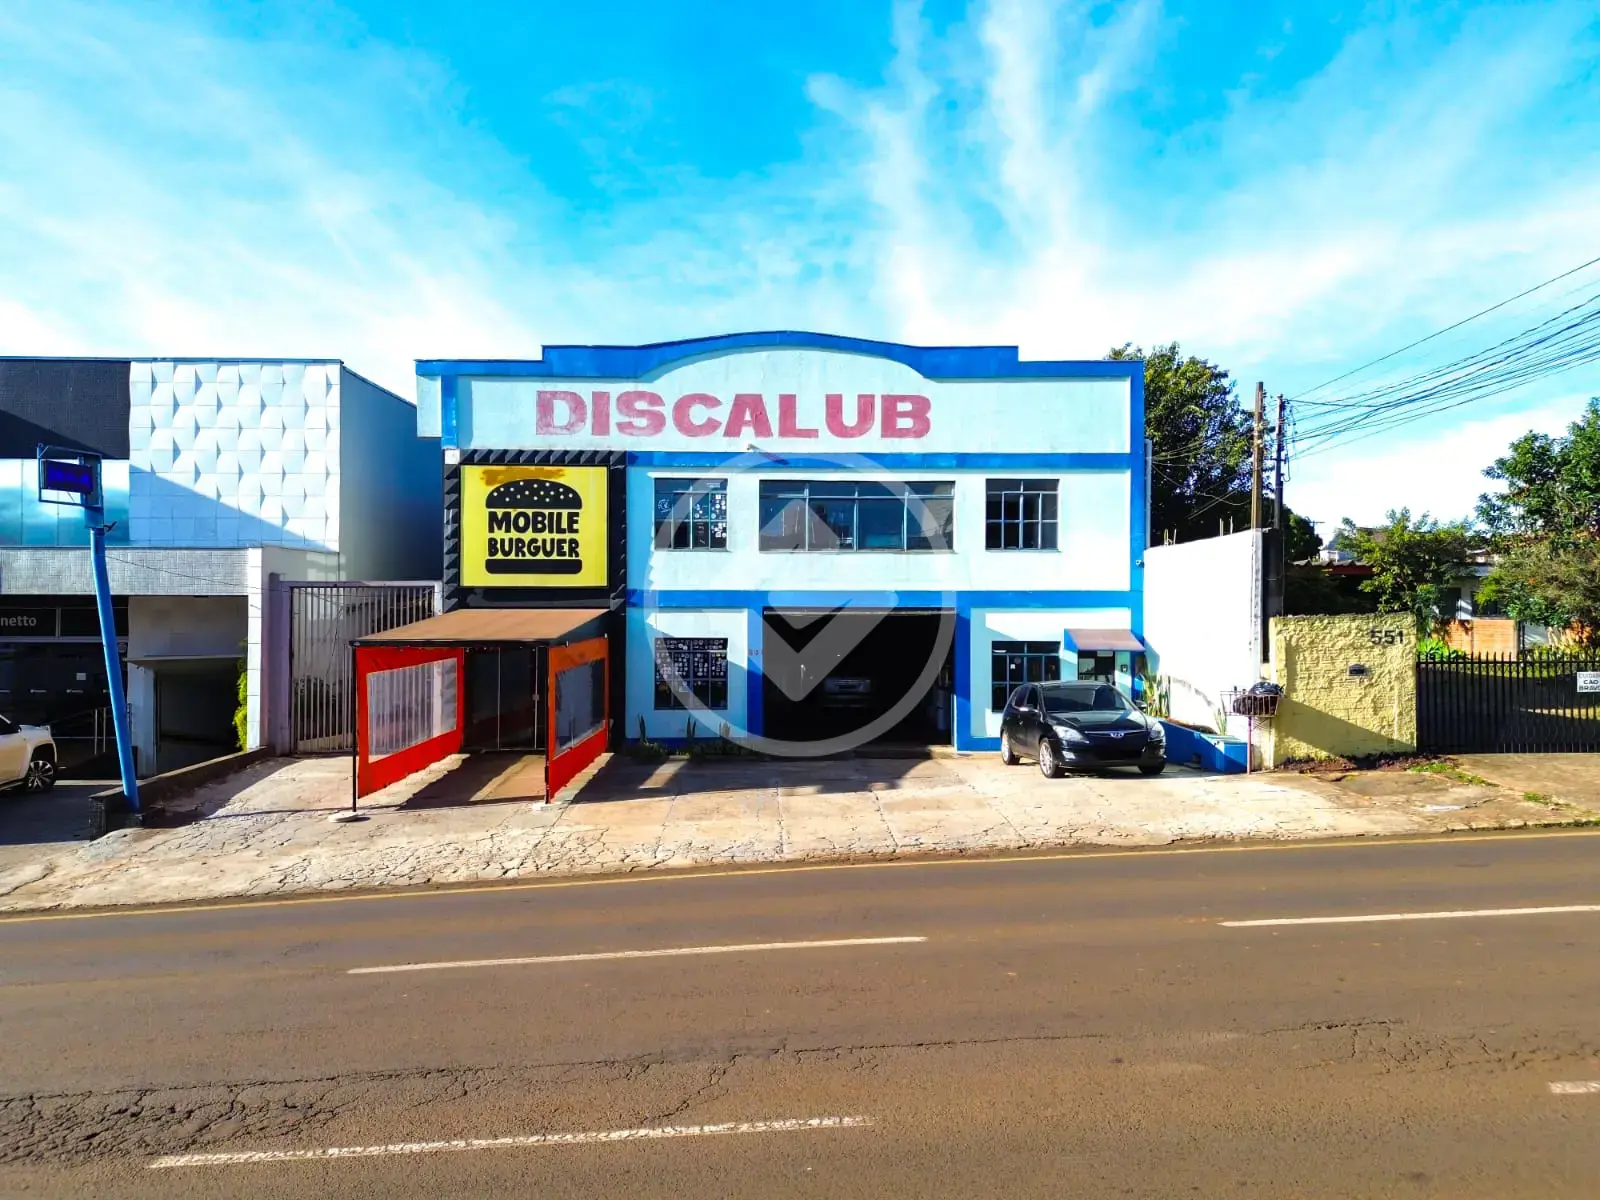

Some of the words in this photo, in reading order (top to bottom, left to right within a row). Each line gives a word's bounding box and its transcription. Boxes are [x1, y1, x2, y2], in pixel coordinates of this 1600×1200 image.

[535, 390, 932, 439] DISCALUB
[487, 511, 580, 534] MOBILE
[487, 537, 580, 558] BURGUER
[1370, 629, 1404, 645] 551
